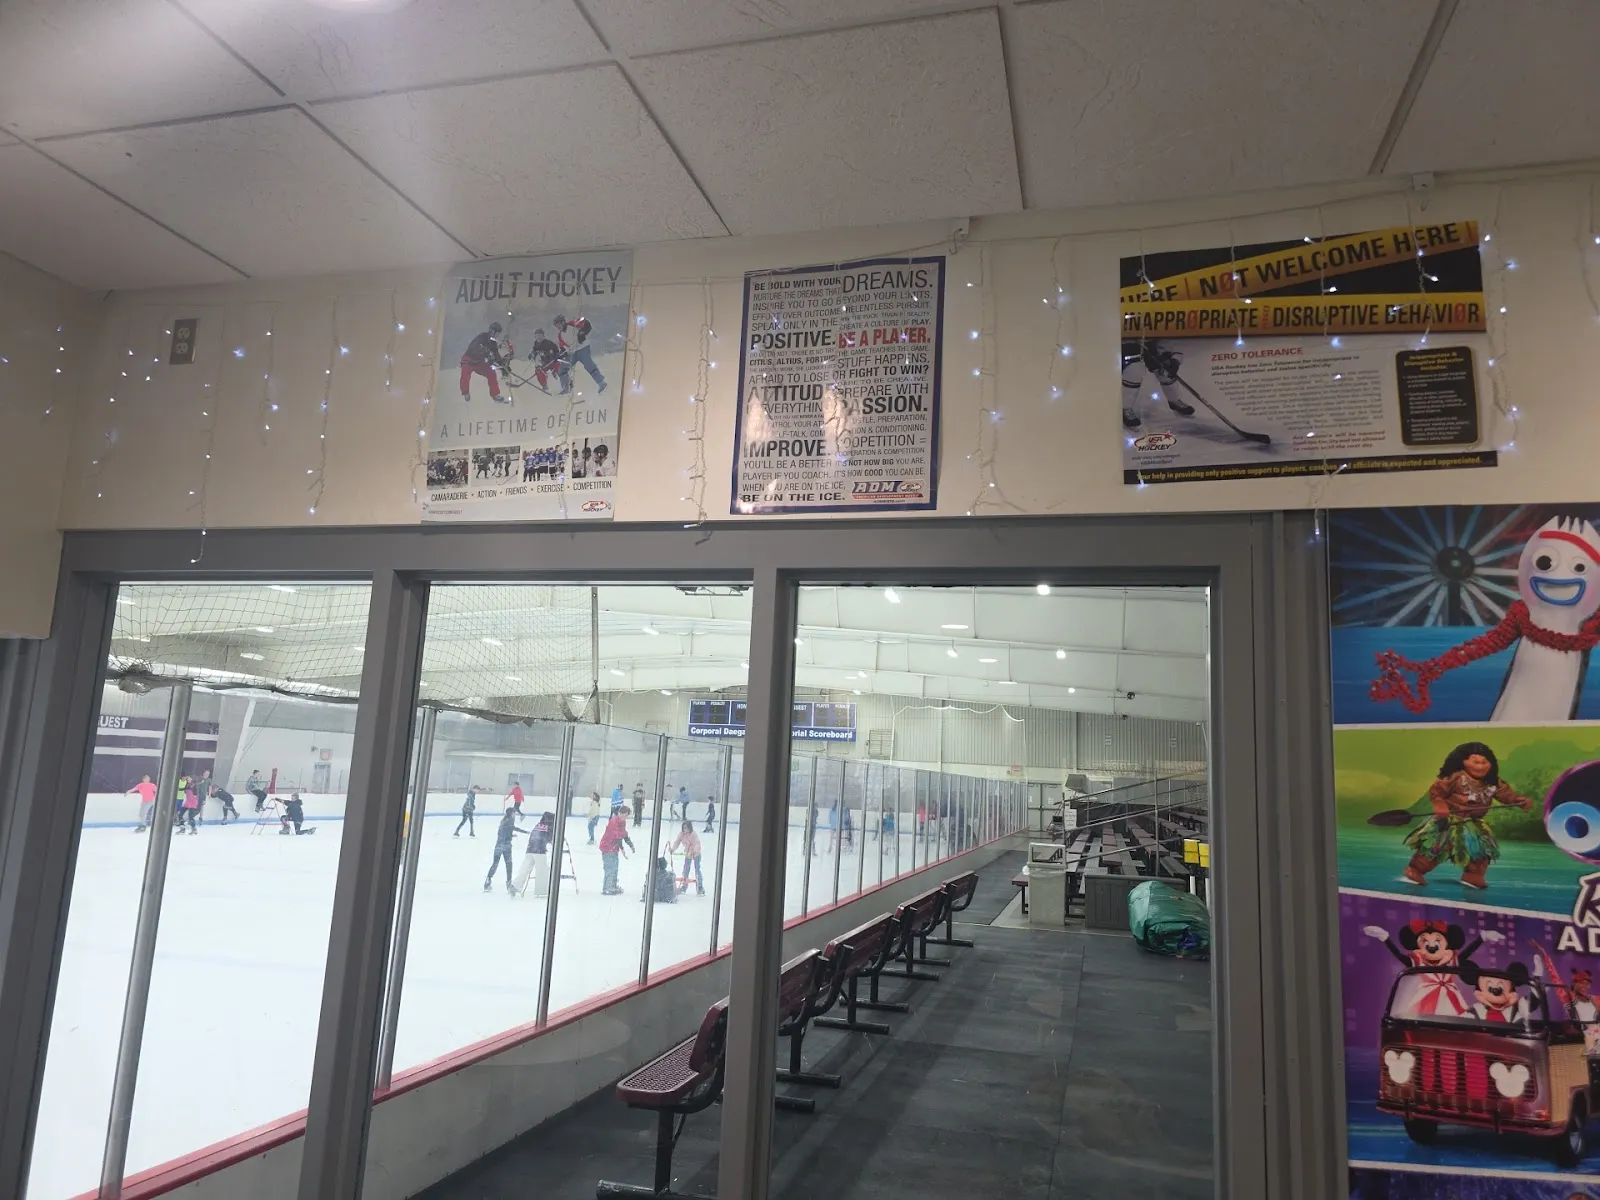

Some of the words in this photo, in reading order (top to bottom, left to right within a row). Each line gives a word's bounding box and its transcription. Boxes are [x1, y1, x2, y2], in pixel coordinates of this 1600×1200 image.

[1255, 238, 1386, 284] WELCOME
[1393, 222, 1460, 254] HERE
[455, 272, 523, 304] ADULT
[528, 267, 622, 298] HOCKEY
[754, 283, 766, 291] BE
[768, 281, 790, 289] BOLD
[793, 279, 815, 288] WITH
[818, 277, 841, 286] YOUR
[842, 269, 933, 293] DREAMS.
[784, 291, 795, 299] THE
[797, 289, 823, 298] DREAMS
[826, 287, 841, 296] THAT
[788, 301, 804, 309] YOU
[808, 299, 818, 308] TO
[821, 298, 833, 307] GO
[873, 291, 897, 300] YOUR
[783, 312, 802, 320] OVER
[846, 302, 894, 313] RELENTLESS
[1273, 305, 1378, 327] DISRUPTIVE
[783, 321, 807, 330] ONLY
[809, 319, 818, 328] IN
[822, 318, 838, 327] THE
[840, 322, 863, 330] CREATE
[751, 330, 836, 350] POSITIVE.
[838, 332, 856, 348] BE
[859, 330, 868, 346] A
[873, 327, 930, 345] PLAYER.
[838, 356, 872, 369] STUFF
[874, 353, 930, 365] HAPPENS.
[1211, 353, 1238, 361] ZERO
[1241, 347, 1303, 359] TOLERANCE
[749, 374, 784, 385] AFRAID
[787, 373, 800, 383] TO
[803, 372, 829, 383] LOSE
[833, 370, 846, 380] OR
[849, 367, 879, 378] FIGHT
[883, 366, 897, 375] TO
[900, 365, 929, 375] WIN?
[748, 384, 834, 402] ATTITUD
[838, 385, 892, 398] PREPARE
[896, 383, 928, 395] WITH
[440, 424, 448, 438] A
[458, 417, 538, 437] LIFETIME
[547, 413, 566, 429] OF
[575, 408, 608, 425] FUN
[794, 420, 811, 428] YOUR
[877, 414, 927, 423] PREPARATION,
[875, 424, 926, 433] CONDITIONING.
[743, 440, 831, 458] IMPROVE.
[883, 447, 925, 455] COMPETITION
[1138, 444, 1172, 452] HOCKEY
[743, 460, 774, 469] YOU'LL
[777, 460, 787, 469] BE
[790, 459, 797, 468] A
[798, 459, 831, 468] BETTER
[1152, 472, 1165, 480] help
[1175, 470, 1204, 480] providing
[1205, 469, 1219, 478] only
[1220, 467, 1246, 477] positive
[1423, 458, 1437, 466] and
[743, 472, 773, 480] PLAYER
[775, 472, 781, 480] IF
[784, 471, 799, 479] YOU
[802, 470, 831, 479] COACH.
[834, 470, 846, 478] IT'S
[847, 469, 863, 477] HOW
[865, 468, 883, 476] GOOD
[885, 468, 898, 476] YOU
[900, 468, 914, 476] CAN
[431, 492, 468, 501] CAMARADERIE
[477, 489, 498, 499] ACTION
[505, 486, 528, 496] FRIENDS
[536, 483, 564, 493] EXERCISE
[573, 480, 612, 491] COMPETITION
[743, 483, 765, 492] WHEN
[784, 482, 799, 491] ARE
[802, 482, 813, 490] ON
[815, 482, 829, 490] THE
[855, 481, 896, 493] ADM
[742, 494, 760, 503] BE
[764, 493, 783, 502] ON
[789, 493, 815, 502] THE
[819, 492, 846, 501] ICE.
[98, 715, 129, 729] UEST
[690, 727, 722, 736] Corporal
[809, 730, 853, 739] Scoreboard
